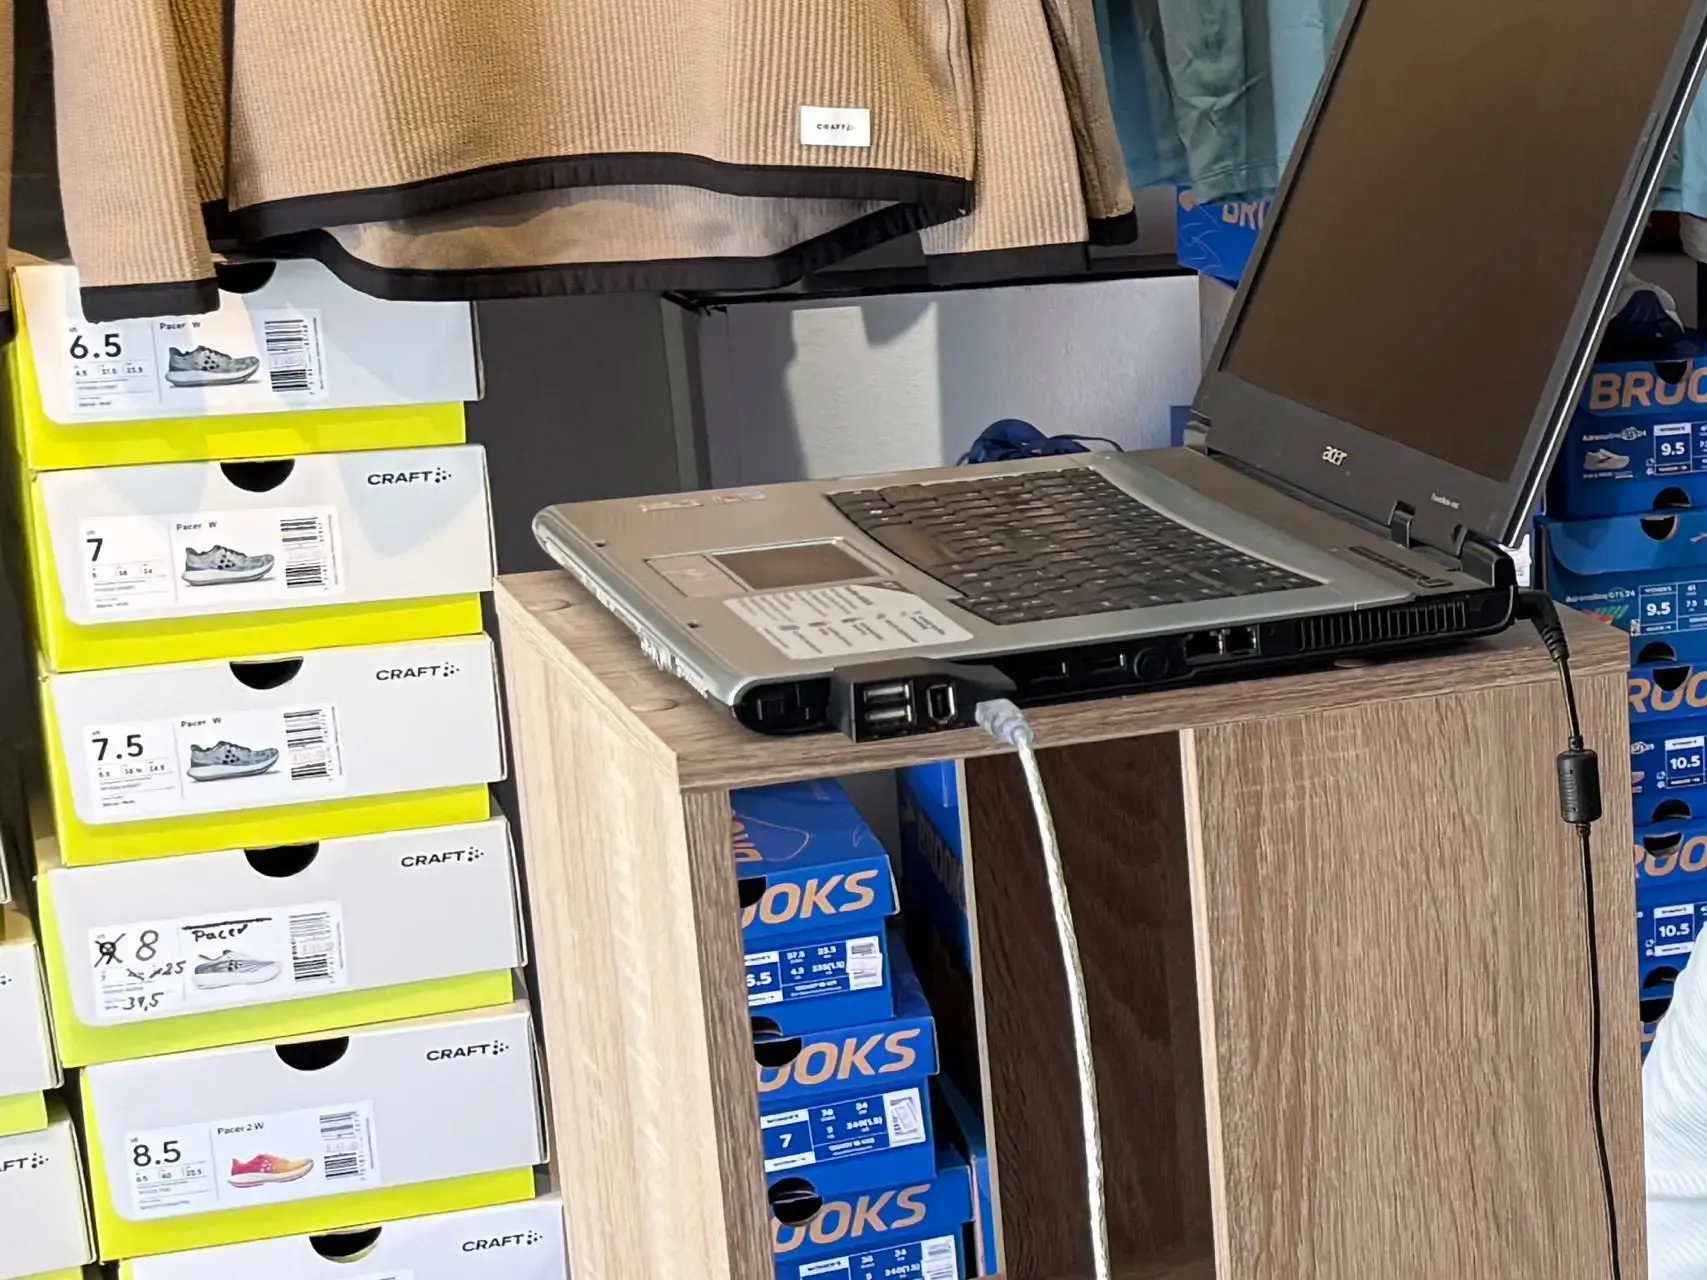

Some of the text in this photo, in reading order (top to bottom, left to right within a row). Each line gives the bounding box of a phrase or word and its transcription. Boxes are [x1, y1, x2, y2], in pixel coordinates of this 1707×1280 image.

[70, 333, 122, 359] 6.5
[1661, 442, 1685, 456] 9.5
[367, 467, 432, 487] CRAFT
[87, 538, 103, 561] 7
[1646, 602, 1671, 617] 9.5
[375, 663, 440, 682] CRAFT
[92, 734, 144, 760] 7.5
[1670, 756, 1700, 770] 10.5
[401, 850, 465, 869] CRAFT
[742, 869, 878, 928] OKS
[1659, 923, 1690, 937] 10.5
[136, 930, 158, 960] 8
[426, 1042, 490, 1061] CRAFT
[254, 1122, 264, 1130] W
[779, 1134, 792, 1148] 7
[133, 1140, 181, 1167] 8.5
[462, 1234, 525, 1253] CRAFT
